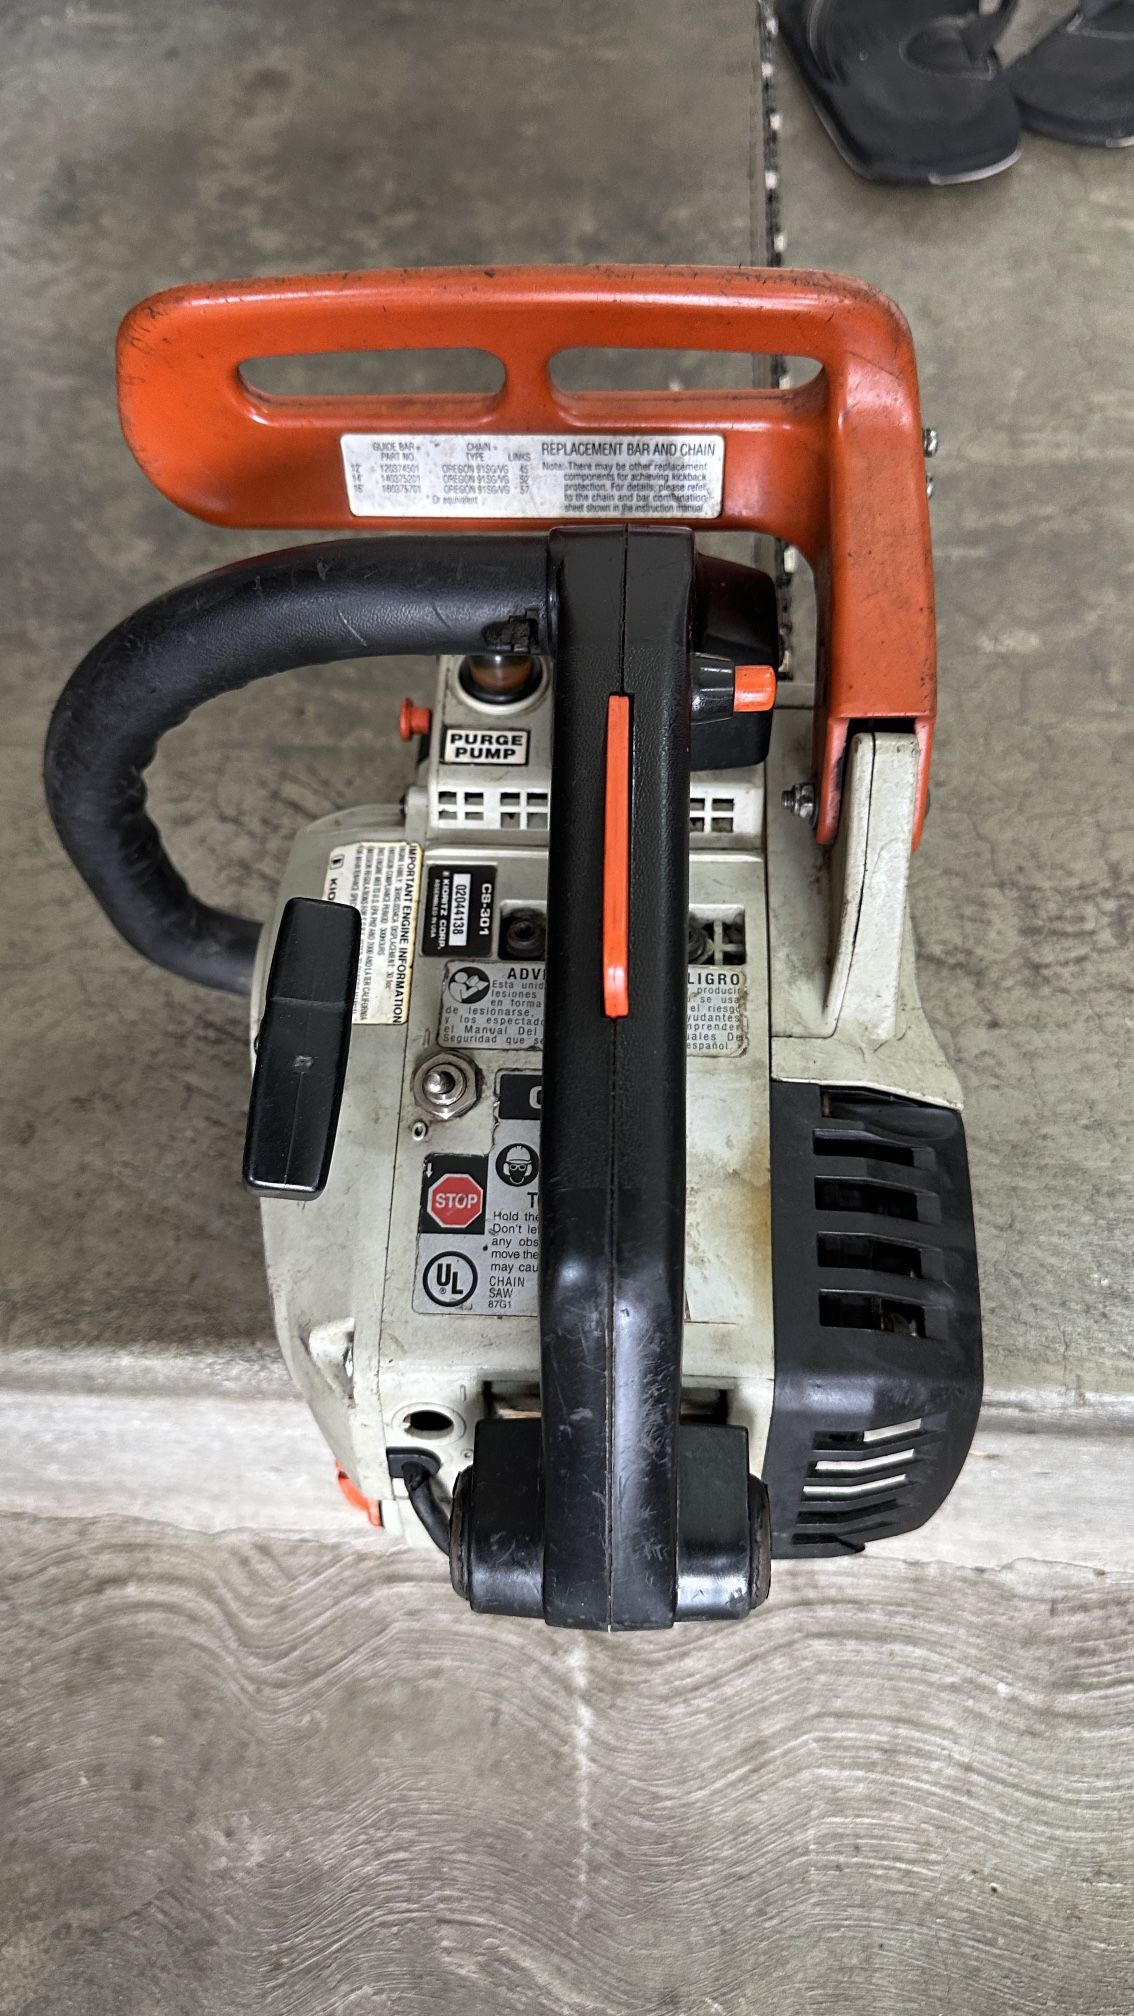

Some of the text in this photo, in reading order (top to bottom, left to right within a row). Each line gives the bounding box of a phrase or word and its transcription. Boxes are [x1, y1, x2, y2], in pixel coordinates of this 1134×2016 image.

[372, 442, 395, 451] GUIDE
[542, 442, 715, 456] REPLACEMENT BAR AND CHAIN
[381, 453, 400, 461] PART
[466, 452, 531, 462] TYPE LINKS
[442, 465, 474, 473] OREGON
[568, 462, 591, 470] There
[594, 463, 613, 474] may
[616, 462, 626, 471] be
[629, 462, 652, 471] other
[654, 462, 707, 471] replacement
[443, 475, 475, 484] OREGON
[564, 473, 615, 481] components
[617, 473, 629, 481] for
[631, 473, 669, 482] achieving
[444, 485, 476, 494] OREGON
[611, 482, 624, 491] For
[658, 483, 684, 493] please
[564, 493, 573, 502] to
[576, 493, 589, 502] the
[592, 493, 615, 502] chain
[618, 493, 633, 502] and
[636, 493, 650, 502] bar
[565, 503, 584, 512] sheet
[586, 504, 610, 512] shown
[613, 504, 619, 512] in
[451, 734, 523, 746] PURGE
[455, 747, 516, 759] PUMP
[432, 878, 440, 916] ASSEMBLED
[438, 879, 450, 950] KIORITZ CORP.
[452, 884, 467, 936] 02044138
[479, 883, 492, 936] CS-301
[367, 928, 376, 940] AND
[392, 845, 417, 1023] IMPORTANT ENGINE INFORMATION
[364, 955, 373, 967] AND
[492, 980, 543, 990] Esta unid
[492, 989, 537, 998] lesiones
[359, 986, 370, 1020] CALIFORNIA
[446, 1006, 534, 1017] de lesionarse.
[465, 1026, 508, 1034] Manual
[518, 1027, 537, 1035] Del
[443, 1034, 497, 1044] Seguridad
[436, 1194, 478, 1208] STOP
[494, 1211, 539, 1222] Hold the
[493, 1224, 522, 1233] Don't
[492, 1237, 538, 1248] any obs
[523, 1250, 538, 1259] the
[491, 1264, 514, 1274] may
[436, 1263, 463, 1294] UL
[490, 1276, 524, 1287] CHAIN
[489, 1288, 513, 1298] SAW
[488, 1300, 511, 1308] 87G1
